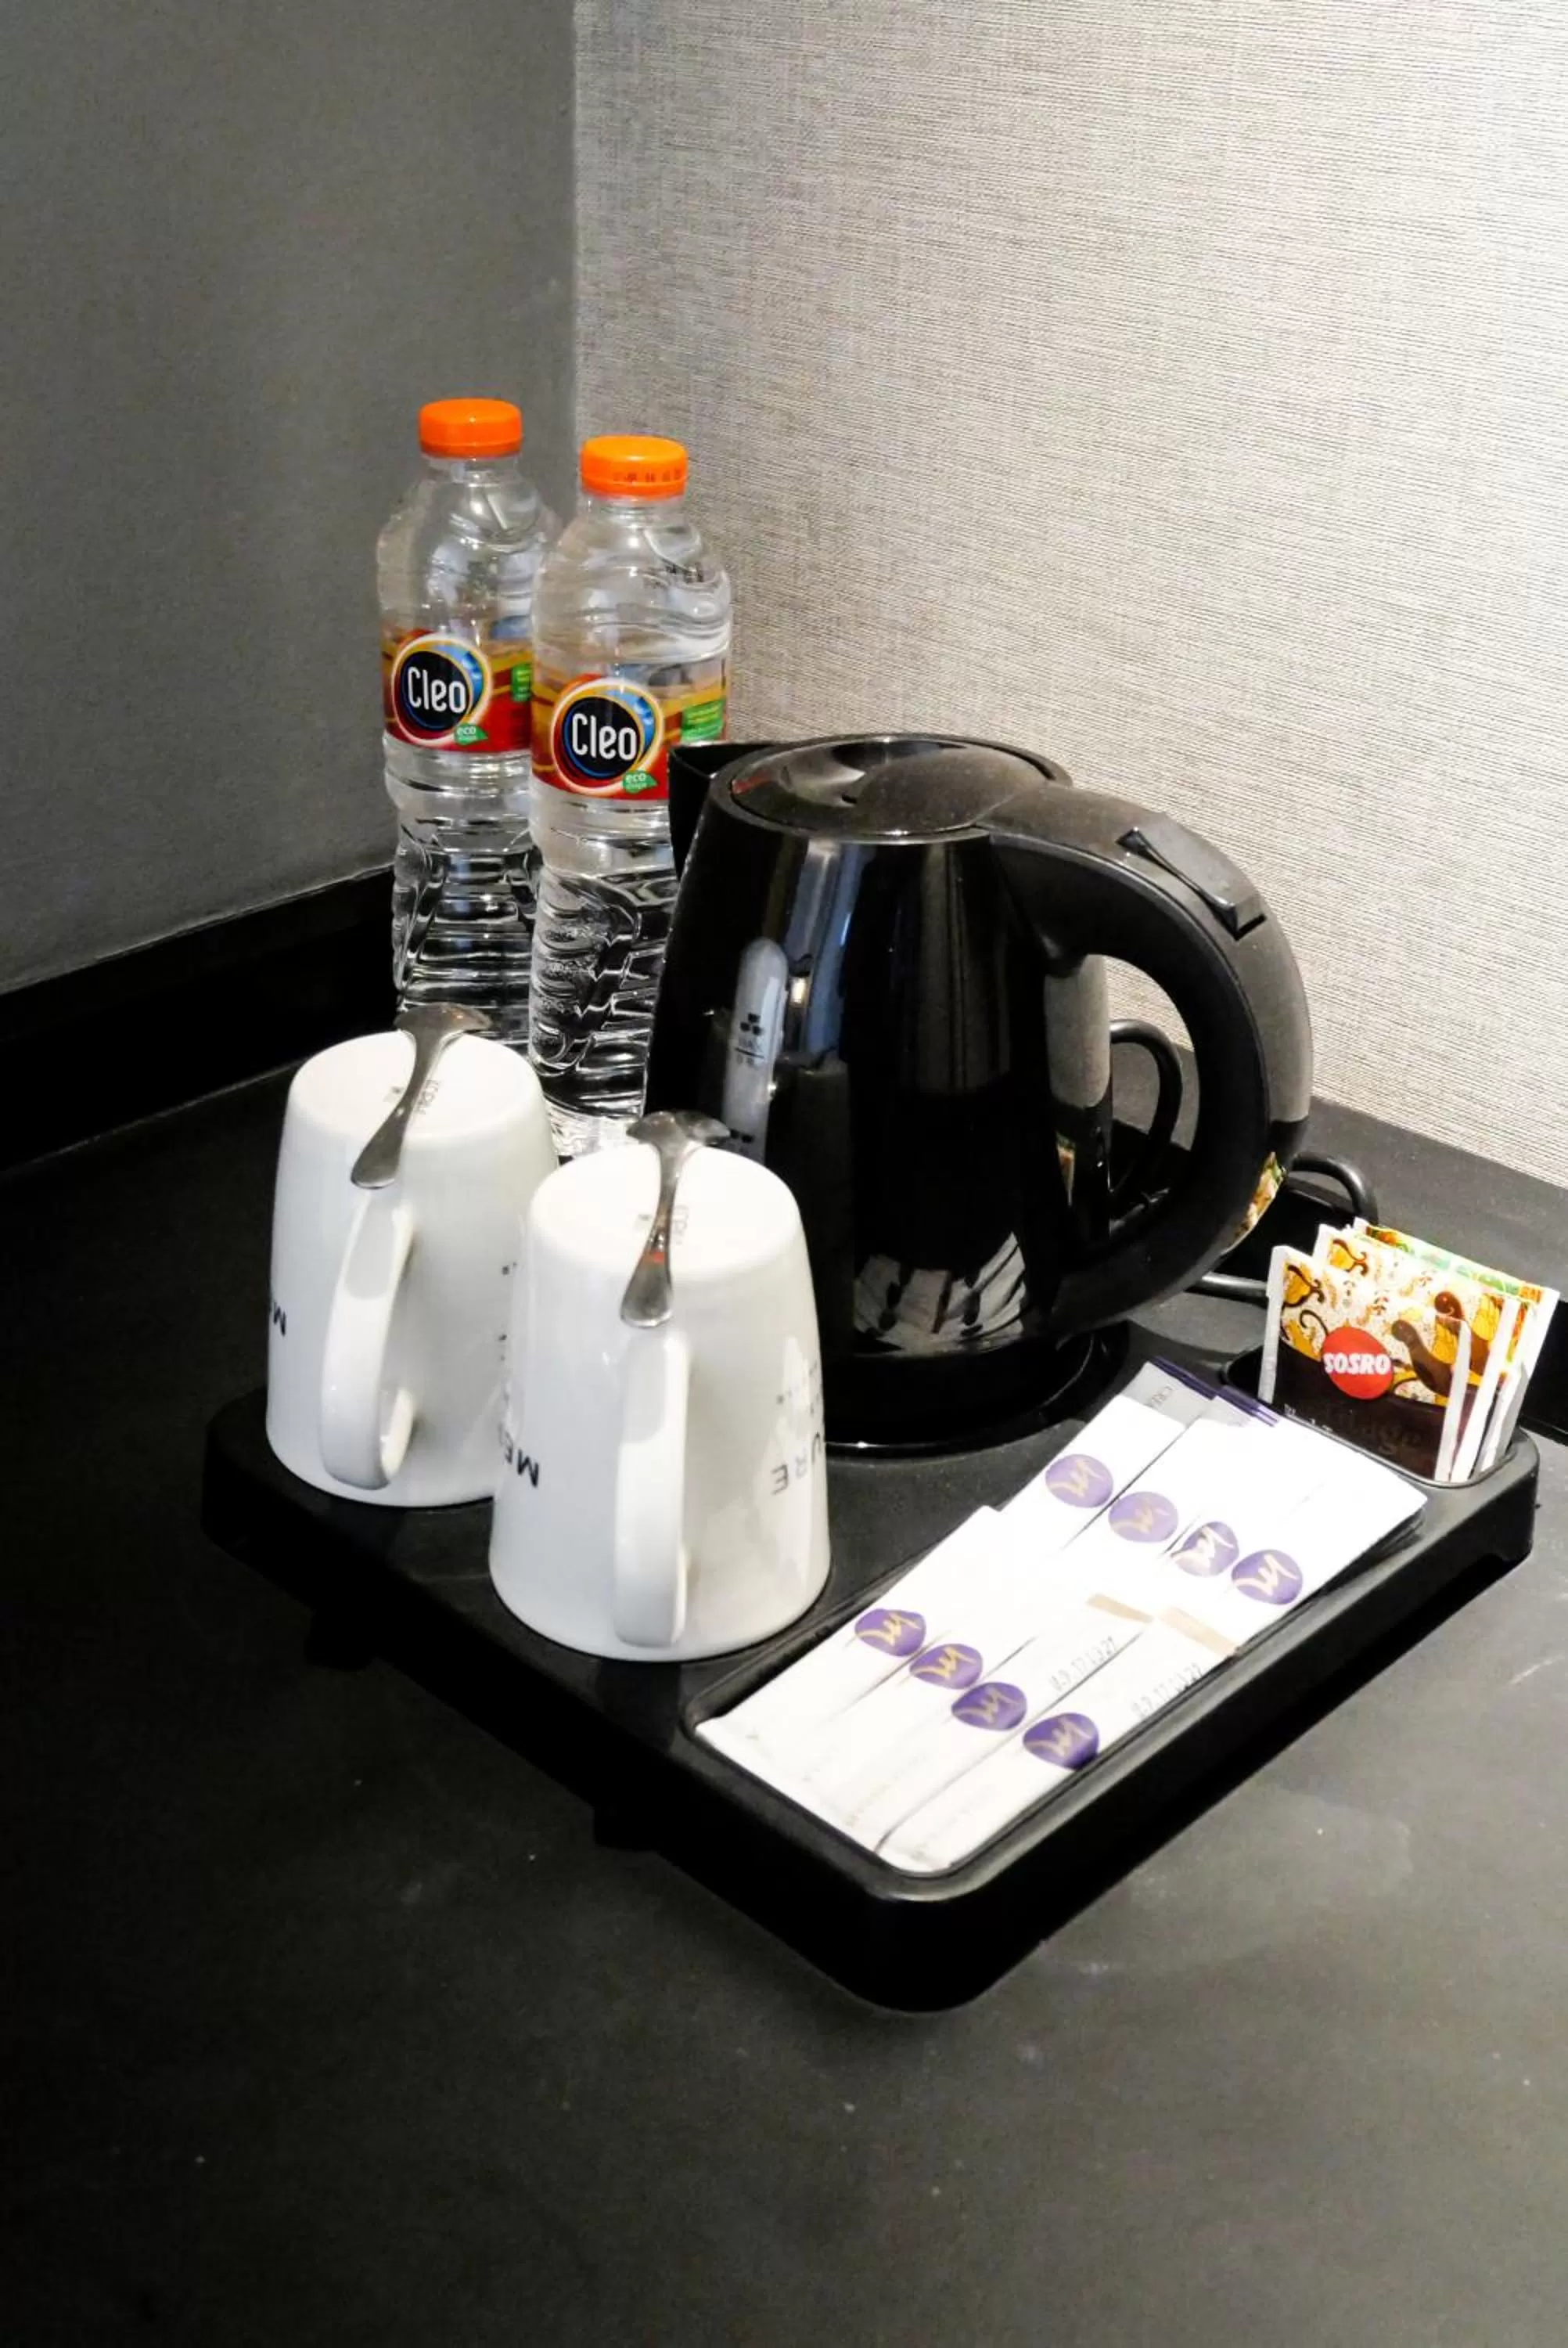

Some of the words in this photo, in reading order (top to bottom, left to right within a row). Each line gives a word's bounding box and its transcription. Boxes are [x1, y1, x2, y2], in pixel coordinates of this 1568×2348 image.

[408, 666, 467, 714] Cleo
[571, 713, 638, 761] Cleo
[625, 772, 646, 784] eco
[1322, 1352, 1392, 1375] SOSRO
